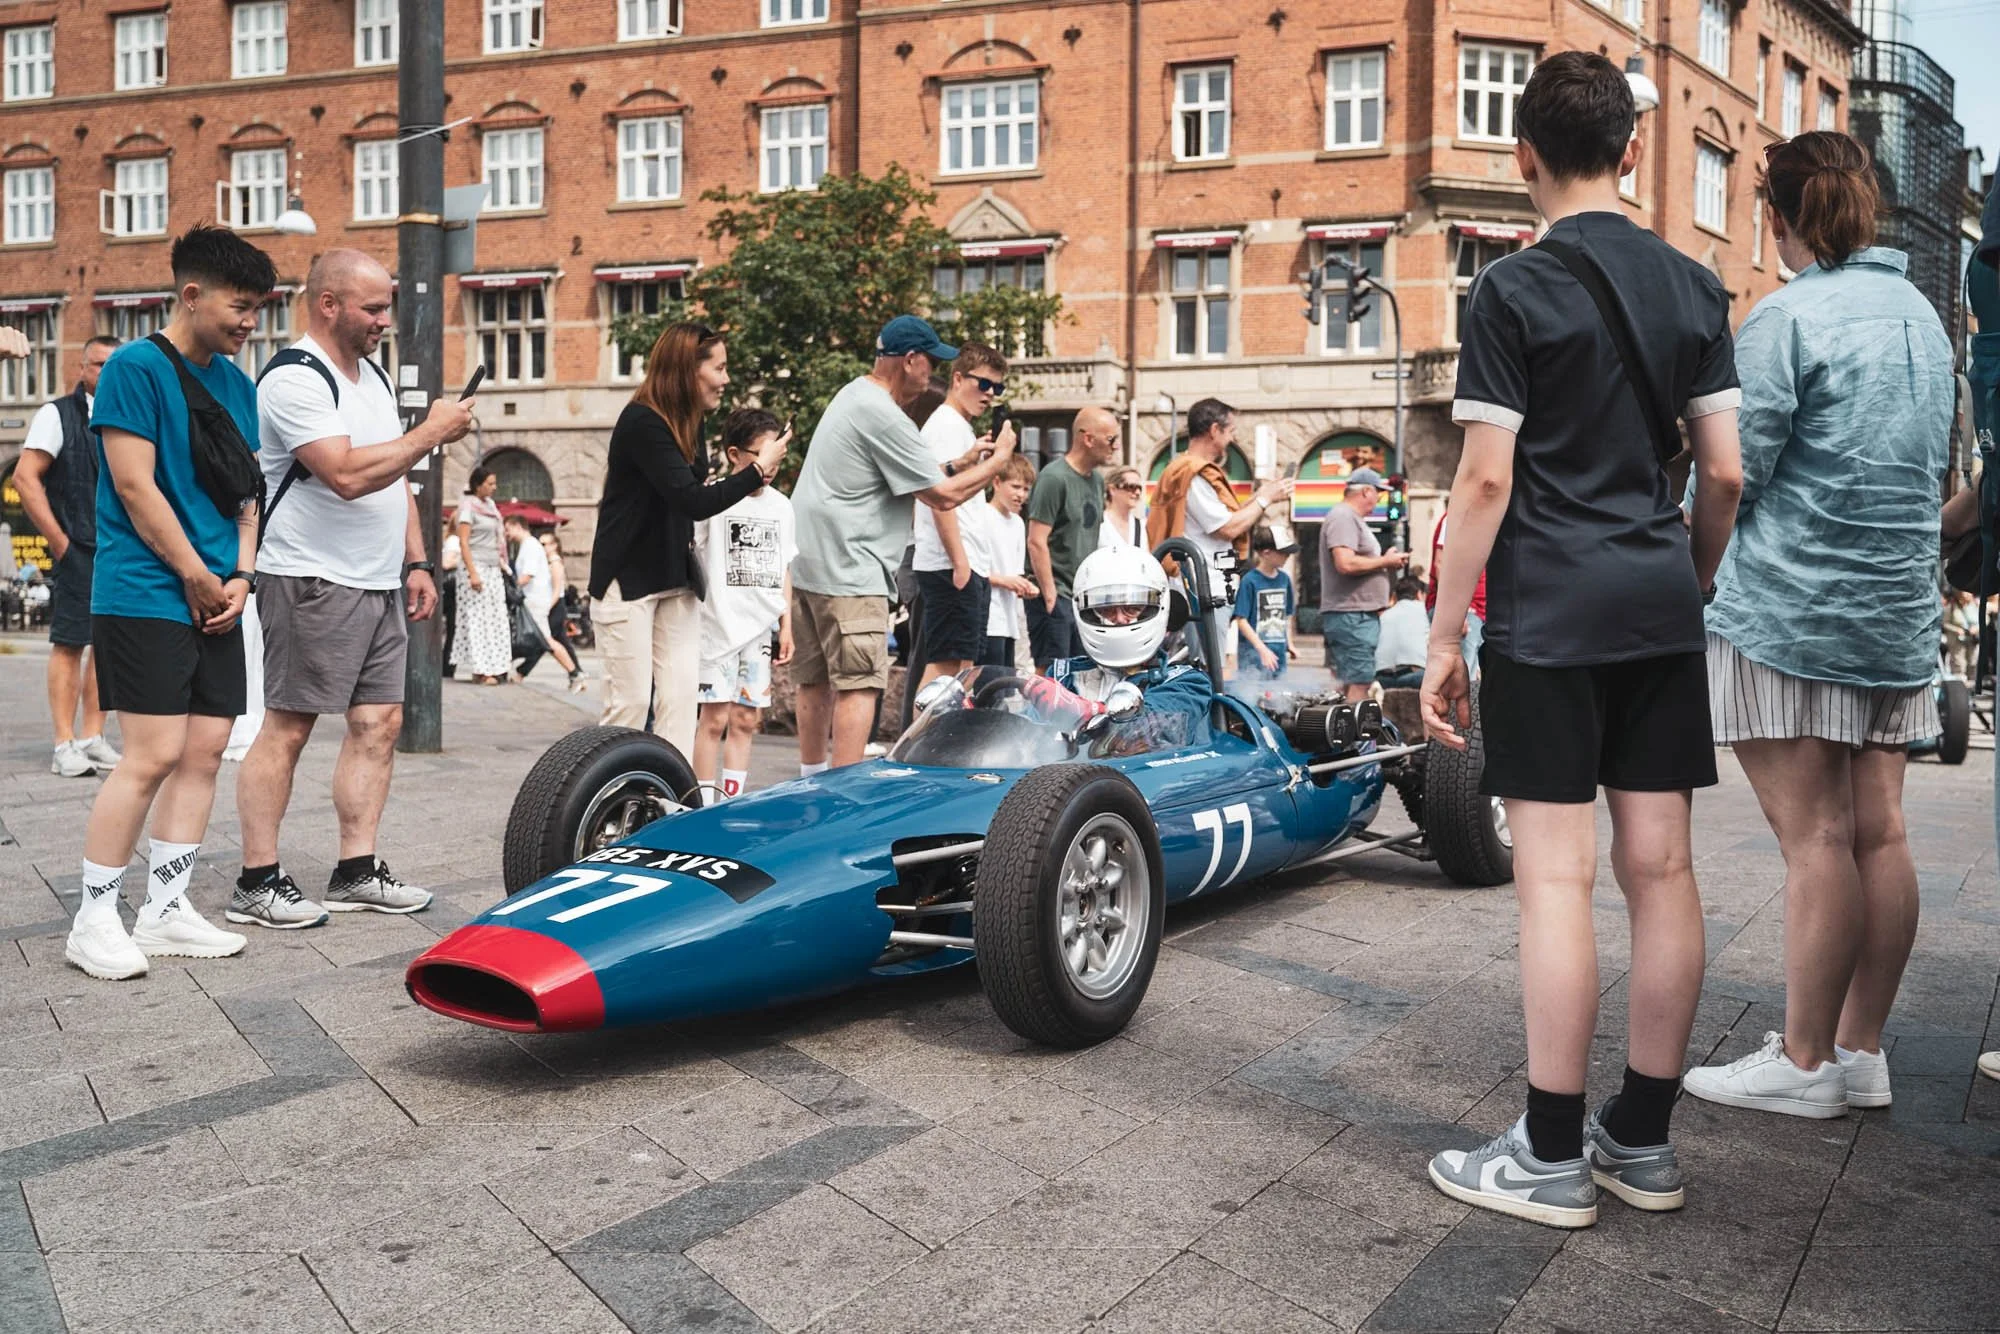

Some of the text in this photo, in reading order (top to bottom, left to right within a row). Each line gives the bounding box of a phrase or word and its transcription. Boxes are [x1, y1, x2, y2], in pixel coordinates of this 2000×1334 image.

[645, 852, 739, 880] XVS
[1188, 802, 1253, 897] 77
[153, 864, 176, 886] THE
[490, 868, 673, 924] 77
